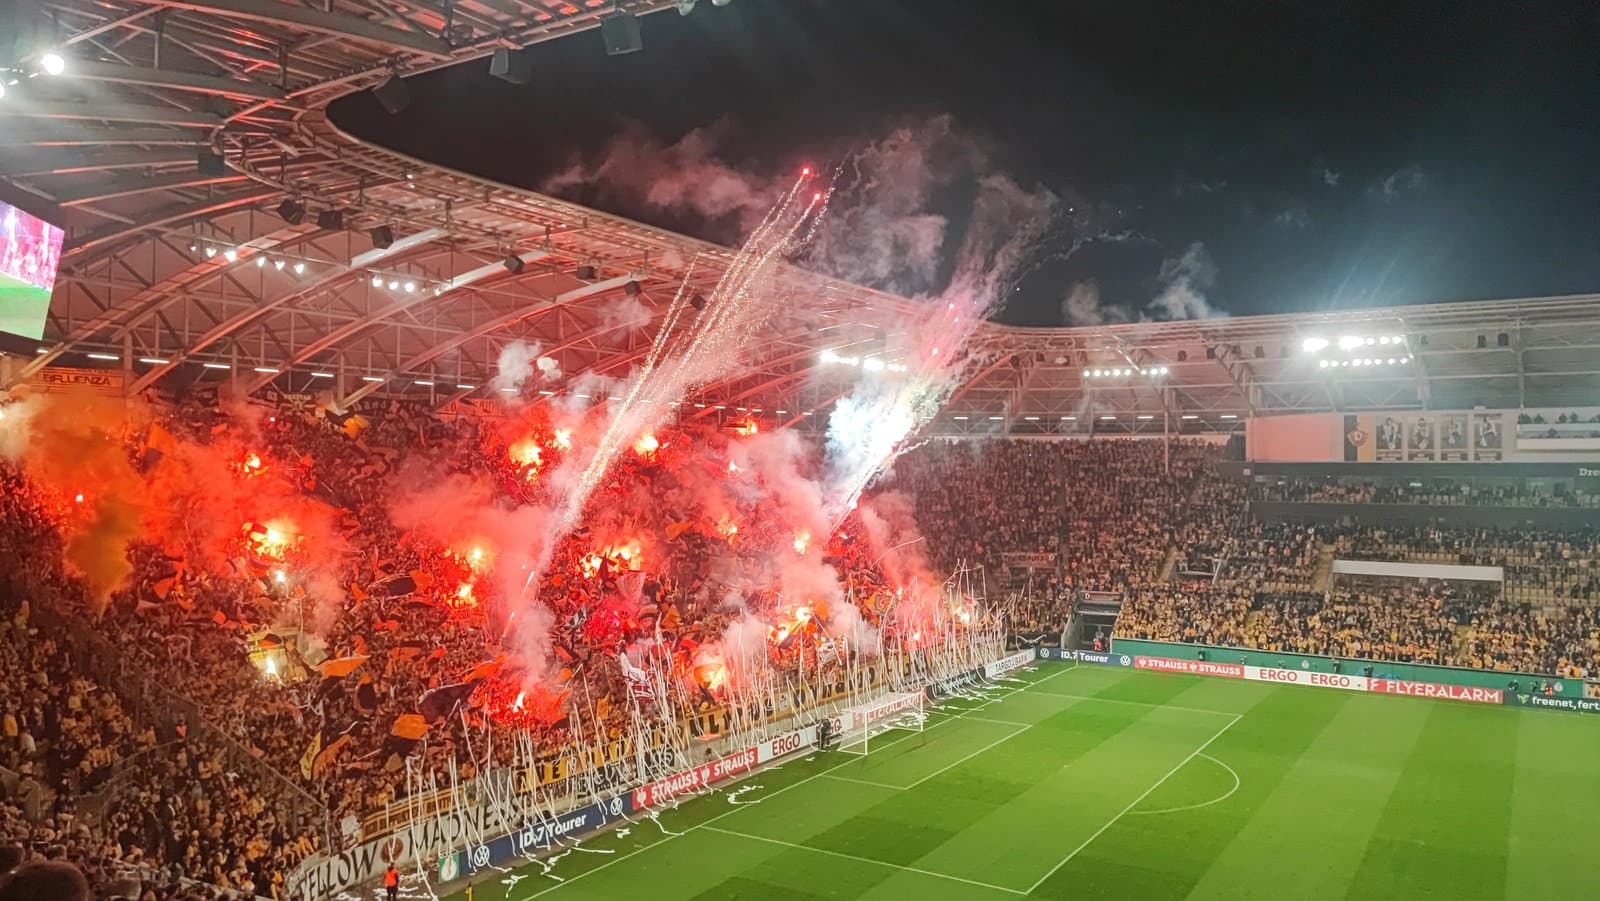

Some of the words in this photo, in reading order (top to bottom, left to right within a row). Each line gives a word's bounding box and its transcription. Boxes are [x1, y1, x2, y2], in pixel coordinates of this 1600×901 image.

[1079, 652, 1109, 663] Tourer
[1147, 659, 1188, 671] STRAUSS
[1199, 664, 1241, 675] STRAUSS
[1259, 668, 1298, 682] ERGO
[1310, 673, 1350, 687] ERGO
[1386, 679, 1500, 702] FLYERALARM
[771, 732, 801, 756] ERGO
[816, 718, 842, 740] EO
[651, 771, 700, 799] STRAUSS
[713, 750, 755, 776] STRAUSS
[545, 814, 587, 838] Tourer
